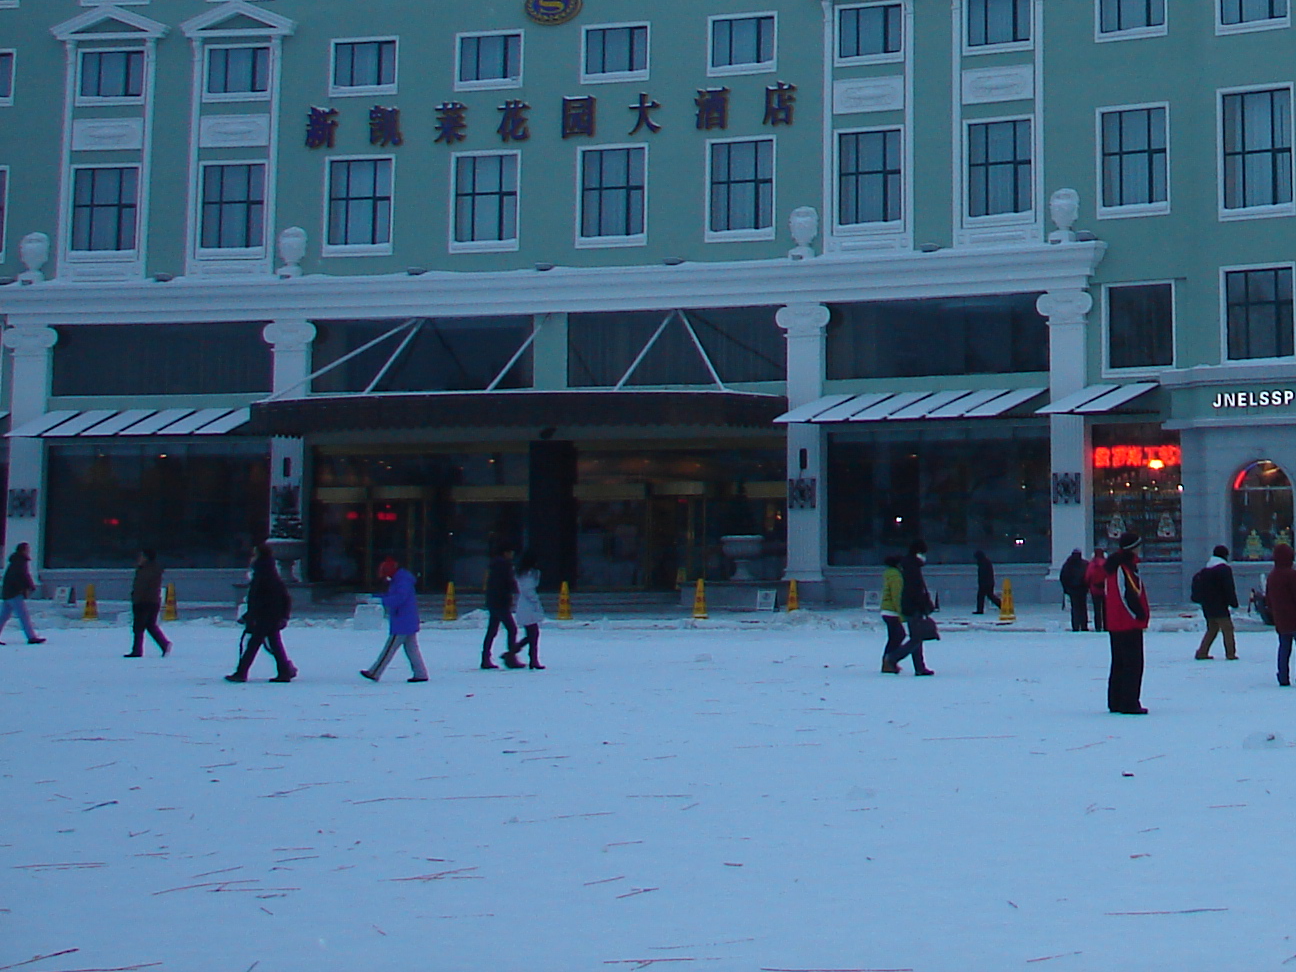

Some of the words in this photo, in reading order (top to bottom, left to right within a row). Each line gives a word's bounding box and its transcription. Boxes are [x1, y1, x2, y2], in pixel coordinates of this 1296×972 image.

[305, 80, 798, 149] 新凯莱花园大酒店
[1212, 390, 1295, 408] JNELSSP
